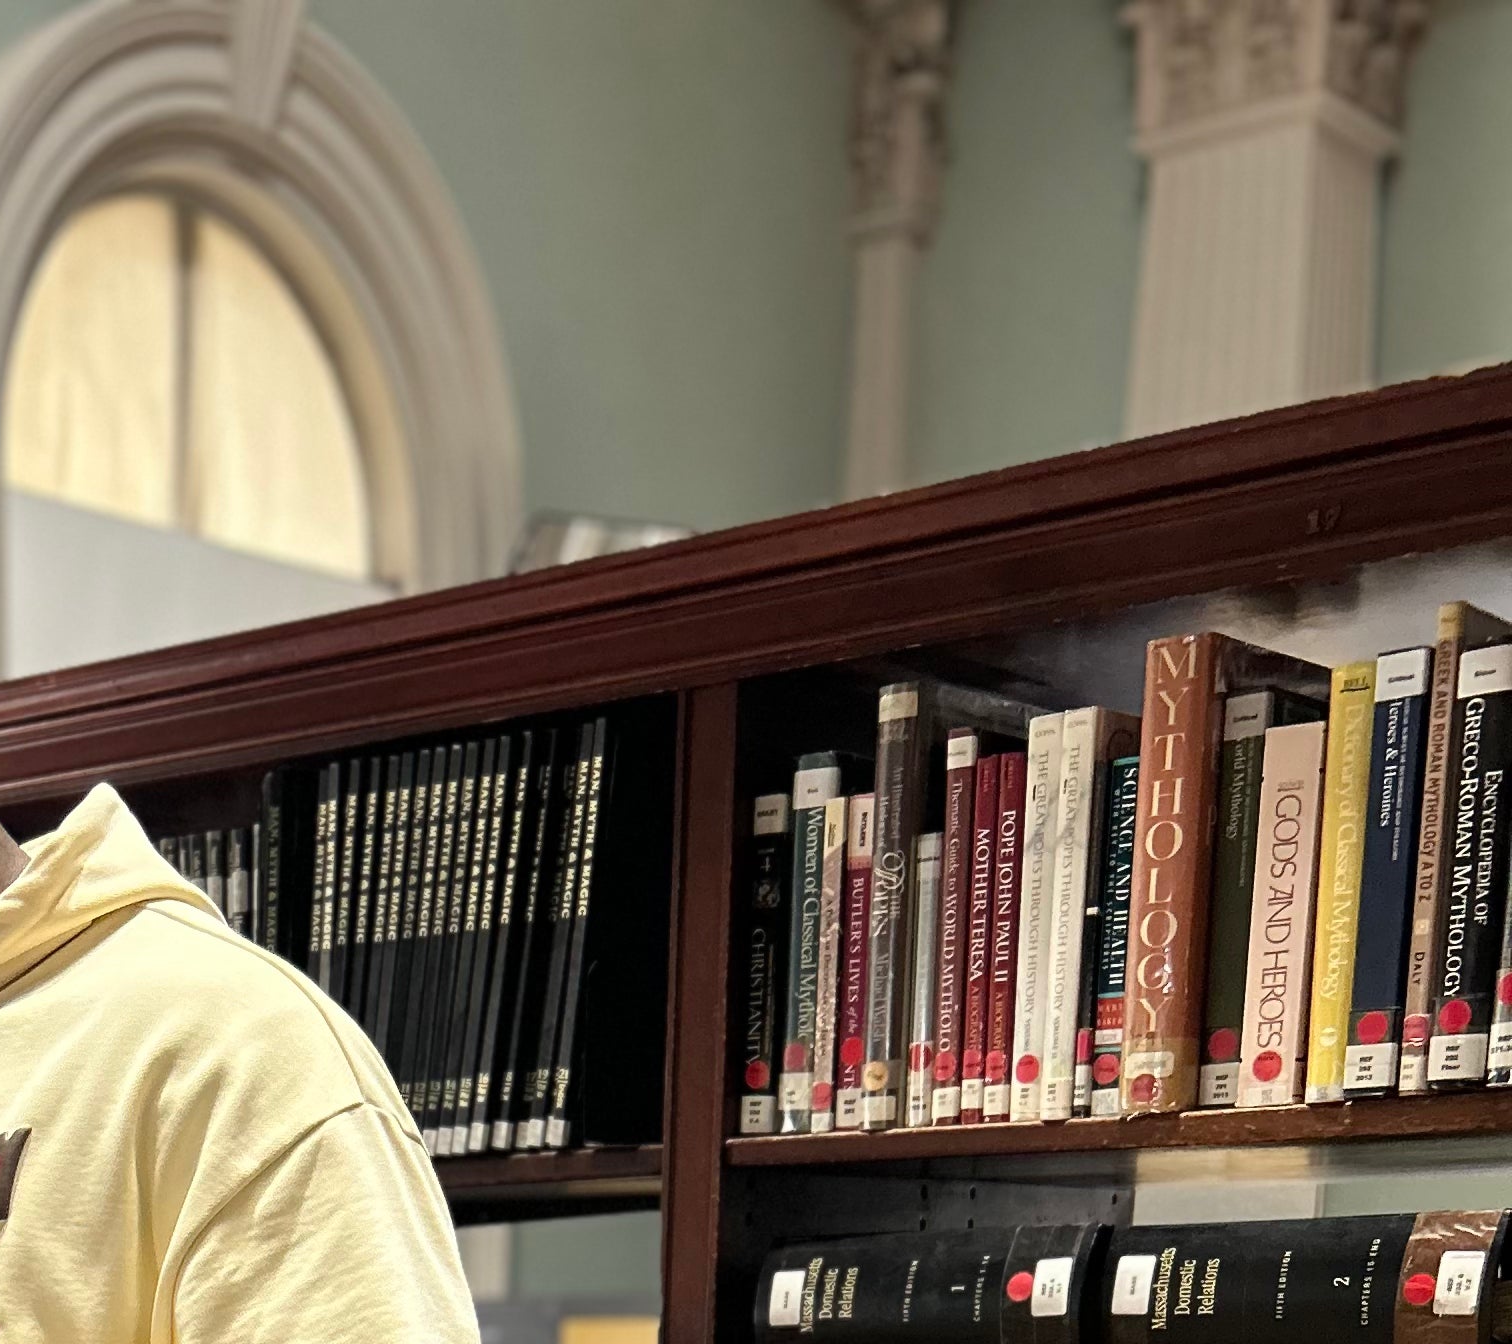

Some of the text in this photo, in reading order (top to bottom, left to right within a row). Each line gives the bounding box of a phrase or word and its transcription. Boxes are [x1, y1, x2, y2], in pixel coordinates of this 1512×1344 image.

[494, 773, 506, 812] MAN,
[576, 761, 589, 799] MAN,
[590, 756, 603, 795] MAN,
[489, 816, 501, 859] MYTH
[571, 804, 583, 846] MYTH
[585, 800, 597, 843] MYTH
[1137, 645, 1198, 1034] MYTHOLOGY
[1271, 795, 1302, 878] GODS
[1444, 699, 1485, 997] GRECO-ROMAN MYTHOLOGY
[1473, 770, 1503, 924] ENCYCLOPEDIA OF
[561, 868, 575, 919] MAGIC
[577, 865, 592, 917] MAGIC
[994, 810, 1016, 982] POPE JOHN PAUL II
[1054, 744, 1081, 1013] THE GREAT POPES THROUGH HISTORY
[1108, 767, 1137, 985] SCIENCE AND HEALTH
[481, 880, 494, 930] MAGIC
[969, 829, 990, 981] MOTHER TERESA
[1265, 886, 1295, 945] AND
[746, 928, 766, 1064] CHRISTIANITY
[1257, 949, 1291, 1049] HEROES
[800, 1258, 823, 1332] Massachusetts
[819, 1269, 838, 1319] Domestic
[838, 1268, 858, 1318] Relations
[1151, 1247, 1176, 1330] Massachusetts
[1174, 1260, 1196, 1315] Domestic
[1197, 1258, 1220, 1315] Relations
[1334, 1276, 1349, 1287] 2
